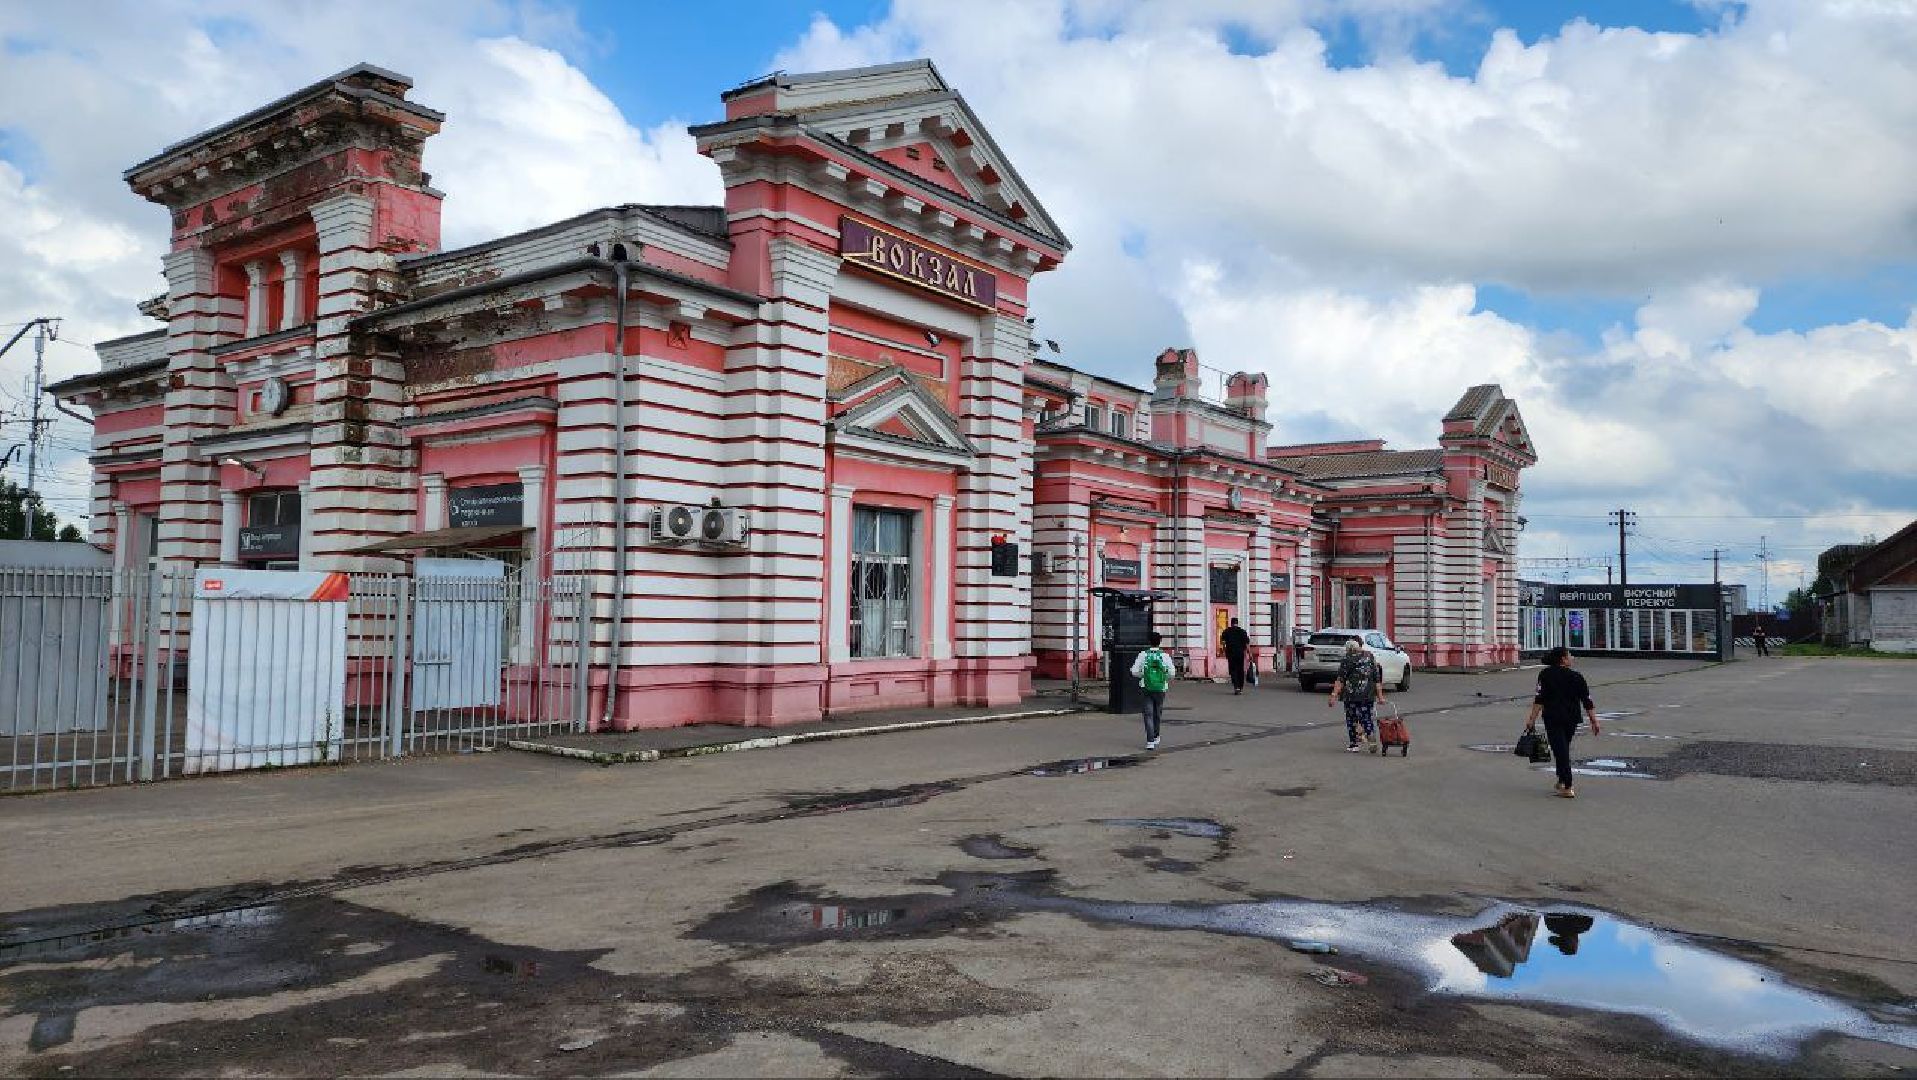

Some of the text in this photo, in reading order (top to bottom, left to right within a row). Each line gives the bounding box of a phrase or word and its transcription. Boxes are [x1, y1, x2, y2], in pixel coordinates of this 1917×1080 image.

[872, 235, 977, 297] ВОКЗАЛ
[1588, 592, 1612, 601] ШОП
[1623, 588, 1676, 598] ВКУСНЫЙ
[1626, 598, 1675, 607] ПЕРЕКУС
